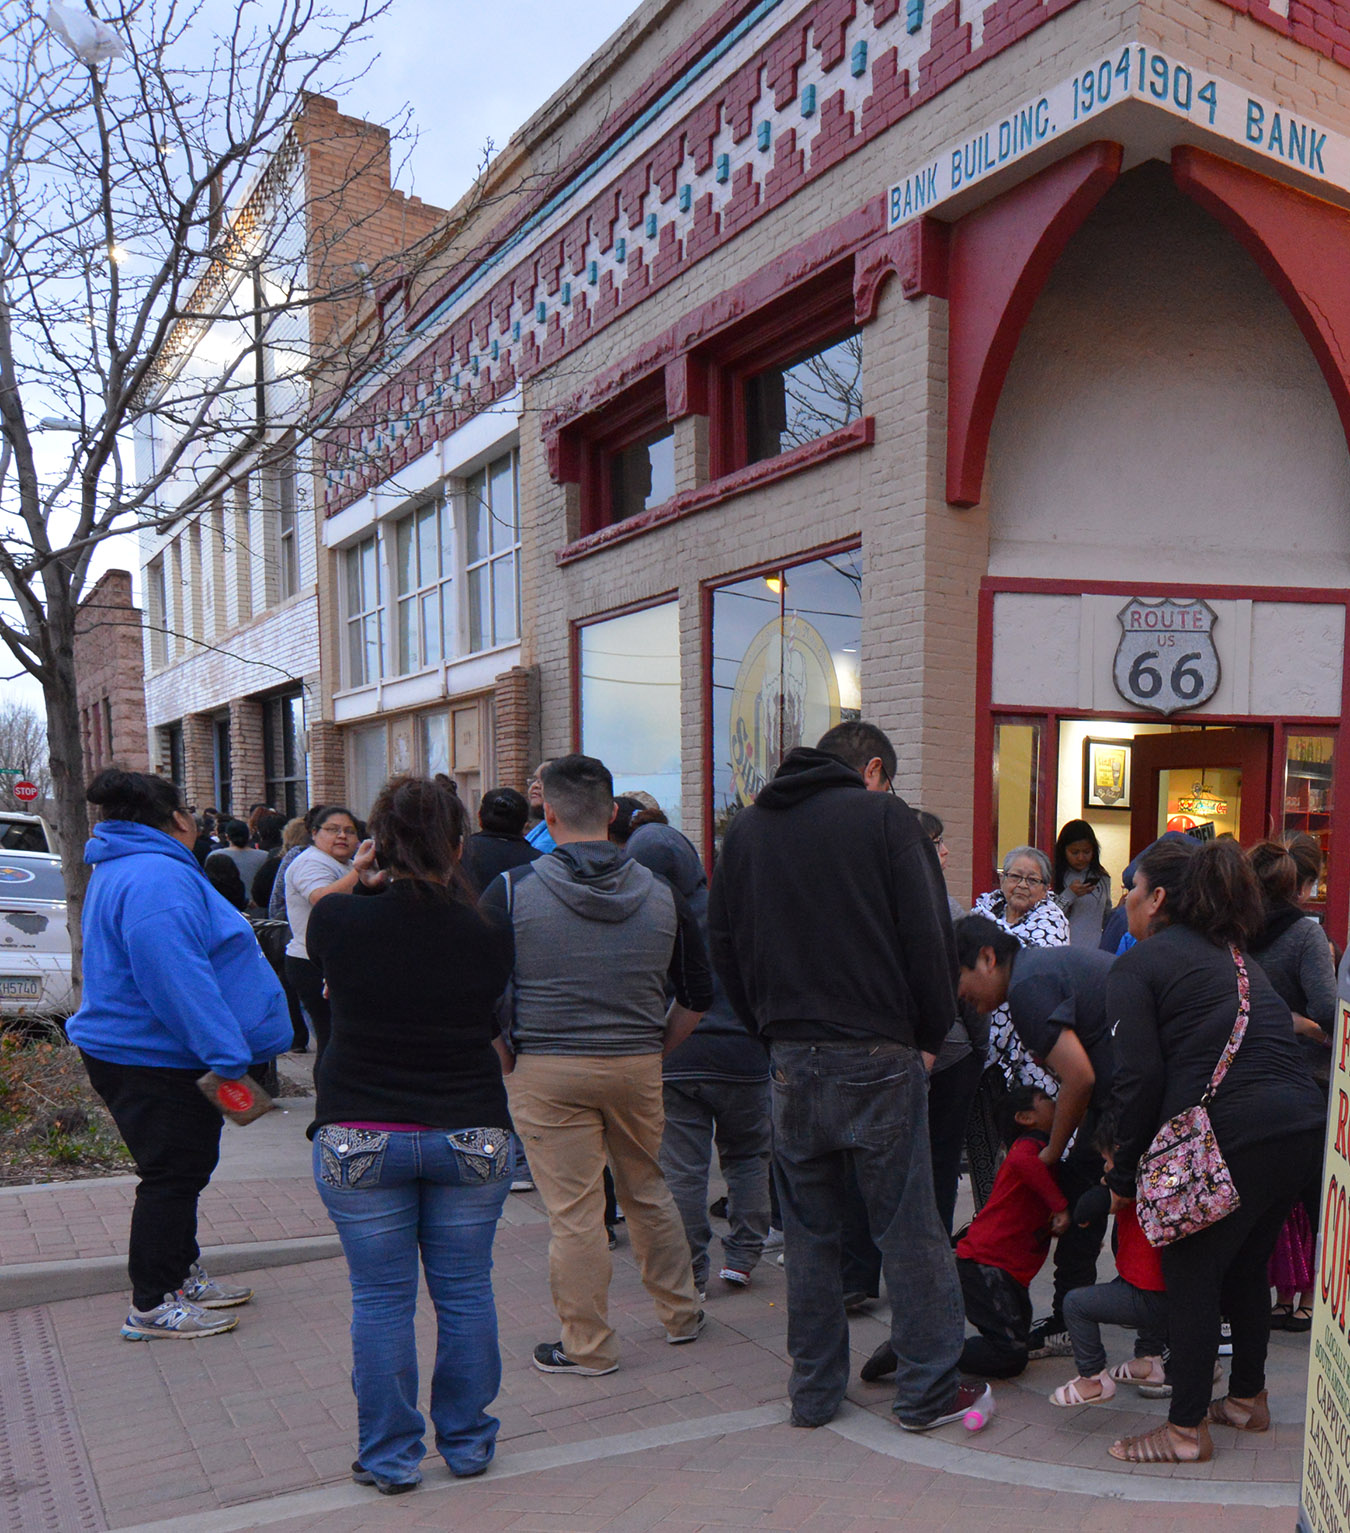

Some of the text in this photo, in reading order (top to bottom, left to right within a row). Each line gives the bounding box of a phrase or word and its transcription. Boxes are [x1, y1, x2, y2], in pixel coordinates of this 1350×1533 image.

[1136, 47, 1217, 125] 1904
[1246, 98, 1327, 174] BANK
[890, 162, 938, 226] BANK
[1072, 47, 1131, 120] 1904
[1130, 610, 1203, 629] ROUTE
[1157, 634, 1176, 648] US
[1128, 650, 1204, 700] 66
[15, 787, 37, 796] STOP
[0, 982, 37, 995] H5740
[1310, 1407, 1334, 1482] LATTE
[1307, 1448, 1343, 1533] ESPRESS
